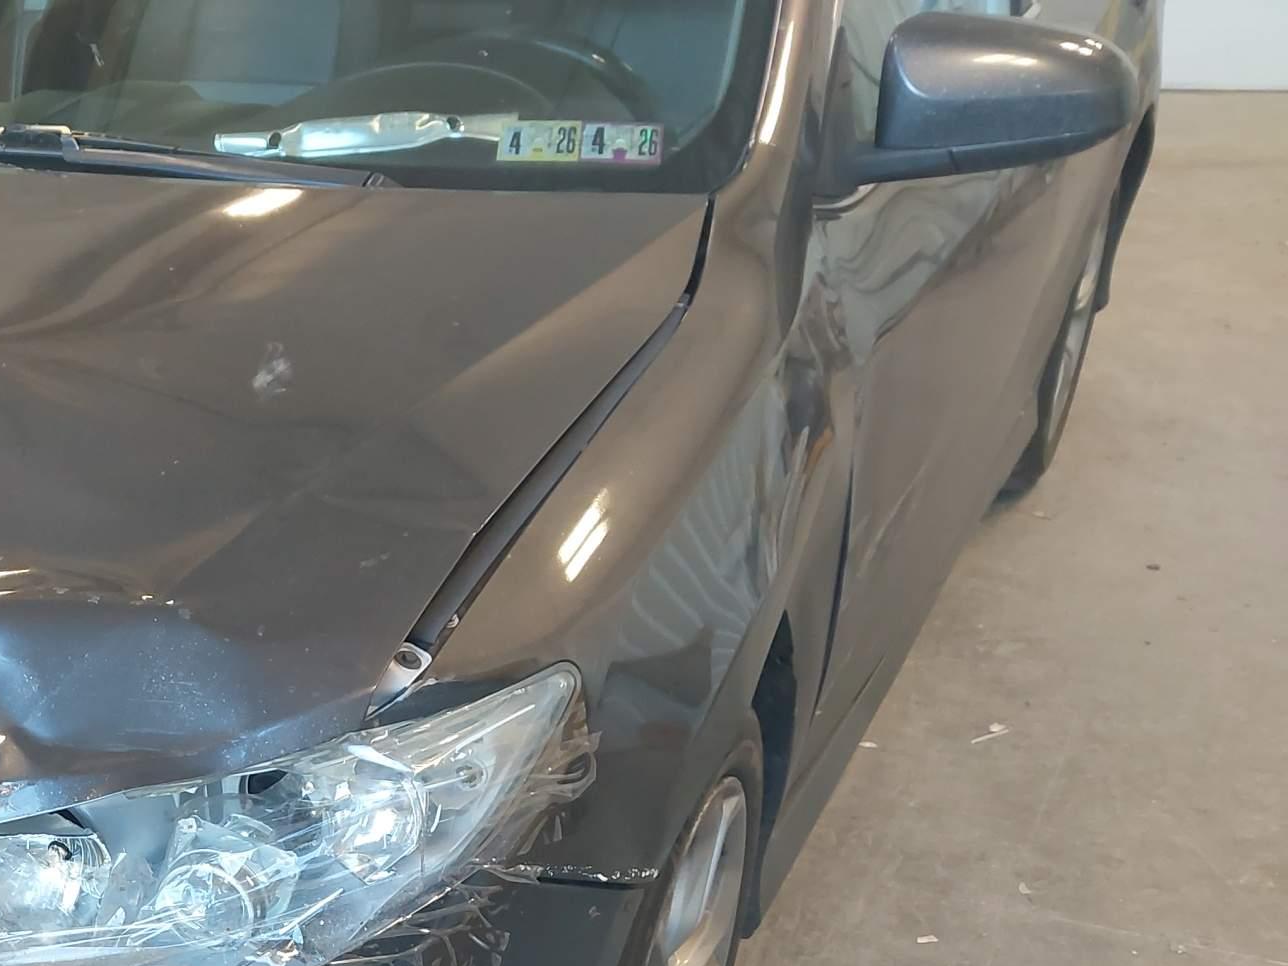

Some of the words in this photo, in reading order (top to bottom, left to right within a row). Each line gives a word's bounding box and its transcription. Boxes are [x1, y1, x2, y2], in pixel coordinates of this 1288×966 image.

[509, 130, 521, 155] 4
[556, 126, 577, 154] 26
[592, 126, 605, 155] 4
[638, 128, 659, 156] 26
